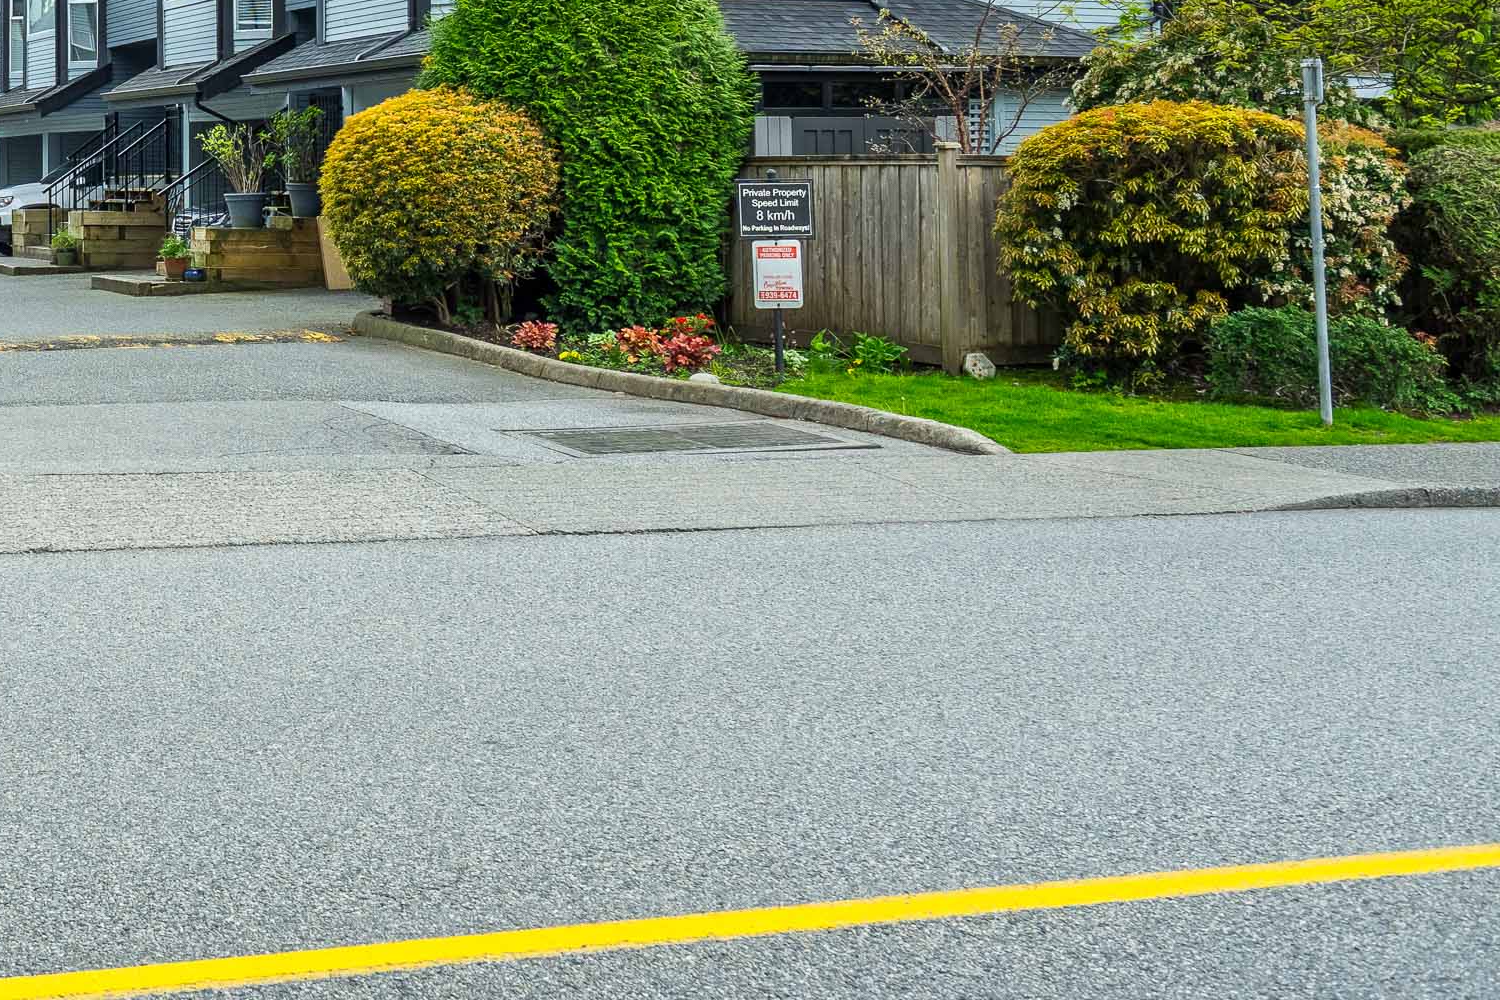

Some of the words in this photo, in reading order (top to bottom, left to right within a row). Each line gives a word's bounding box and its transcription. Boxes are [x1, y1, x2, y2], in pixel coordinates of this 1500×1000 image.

[742, 188, 771, 197] Private
[772, 188, 806, 199] Property
[751, 199, 778, 208] Speed
[779, 198, 799, 207] Limit
[756, 210, 764, 221] 8
[766, 209, 795, 221] km/h
[751, 225, 773, 233] Parking
